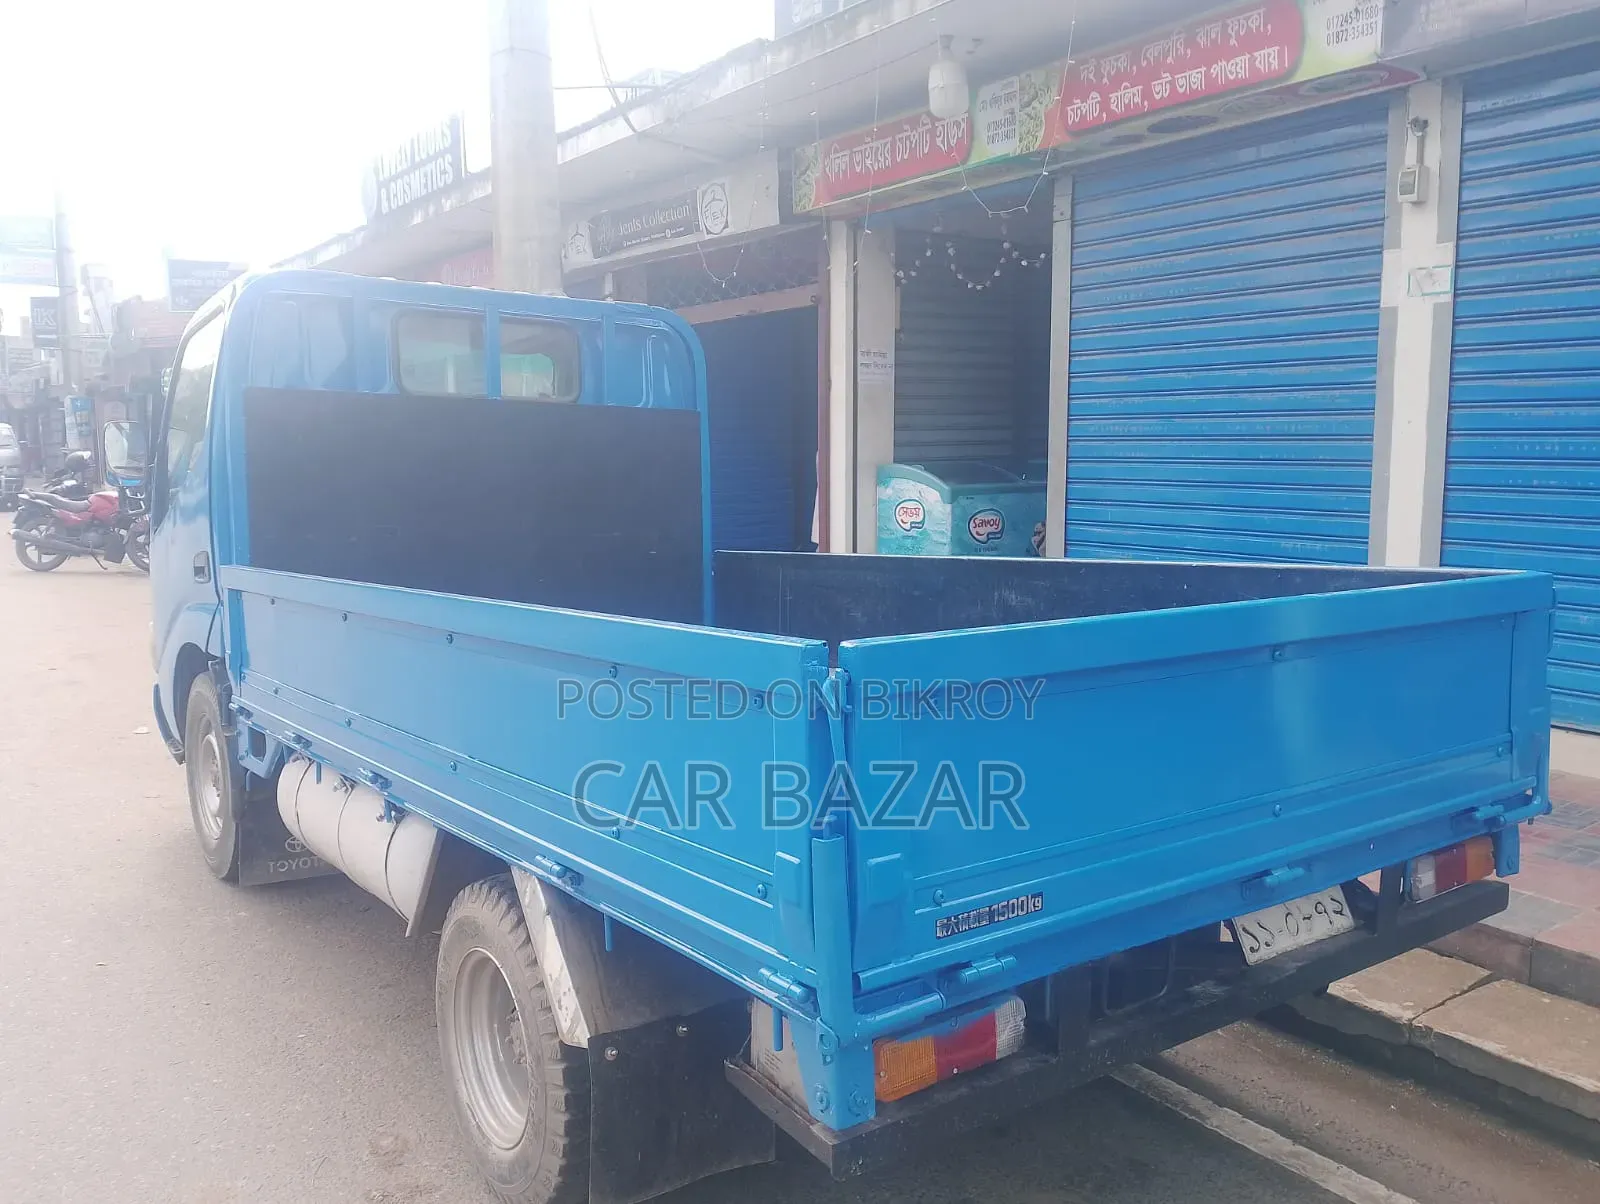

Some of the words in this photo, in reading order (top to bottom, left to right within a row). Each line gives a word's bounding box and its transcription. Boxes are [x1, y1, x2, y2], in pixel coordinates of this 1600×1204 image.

[1067, 91, 1107, 126] চটপটি,
[1109, 82, 1149, 112] হালিম,
[1174, 66, 1207, 95] ভাজা
[1211, 53, 1251, 85] পাওয়া
[853, 135, 893, 172] ভাইয়ের
[896, 113, 932, 163] চটপটি
[381, 188, 389, 216] &
[390, 153, 454, 210] COSMETICS
[642, 203, 690, 228] Collection
